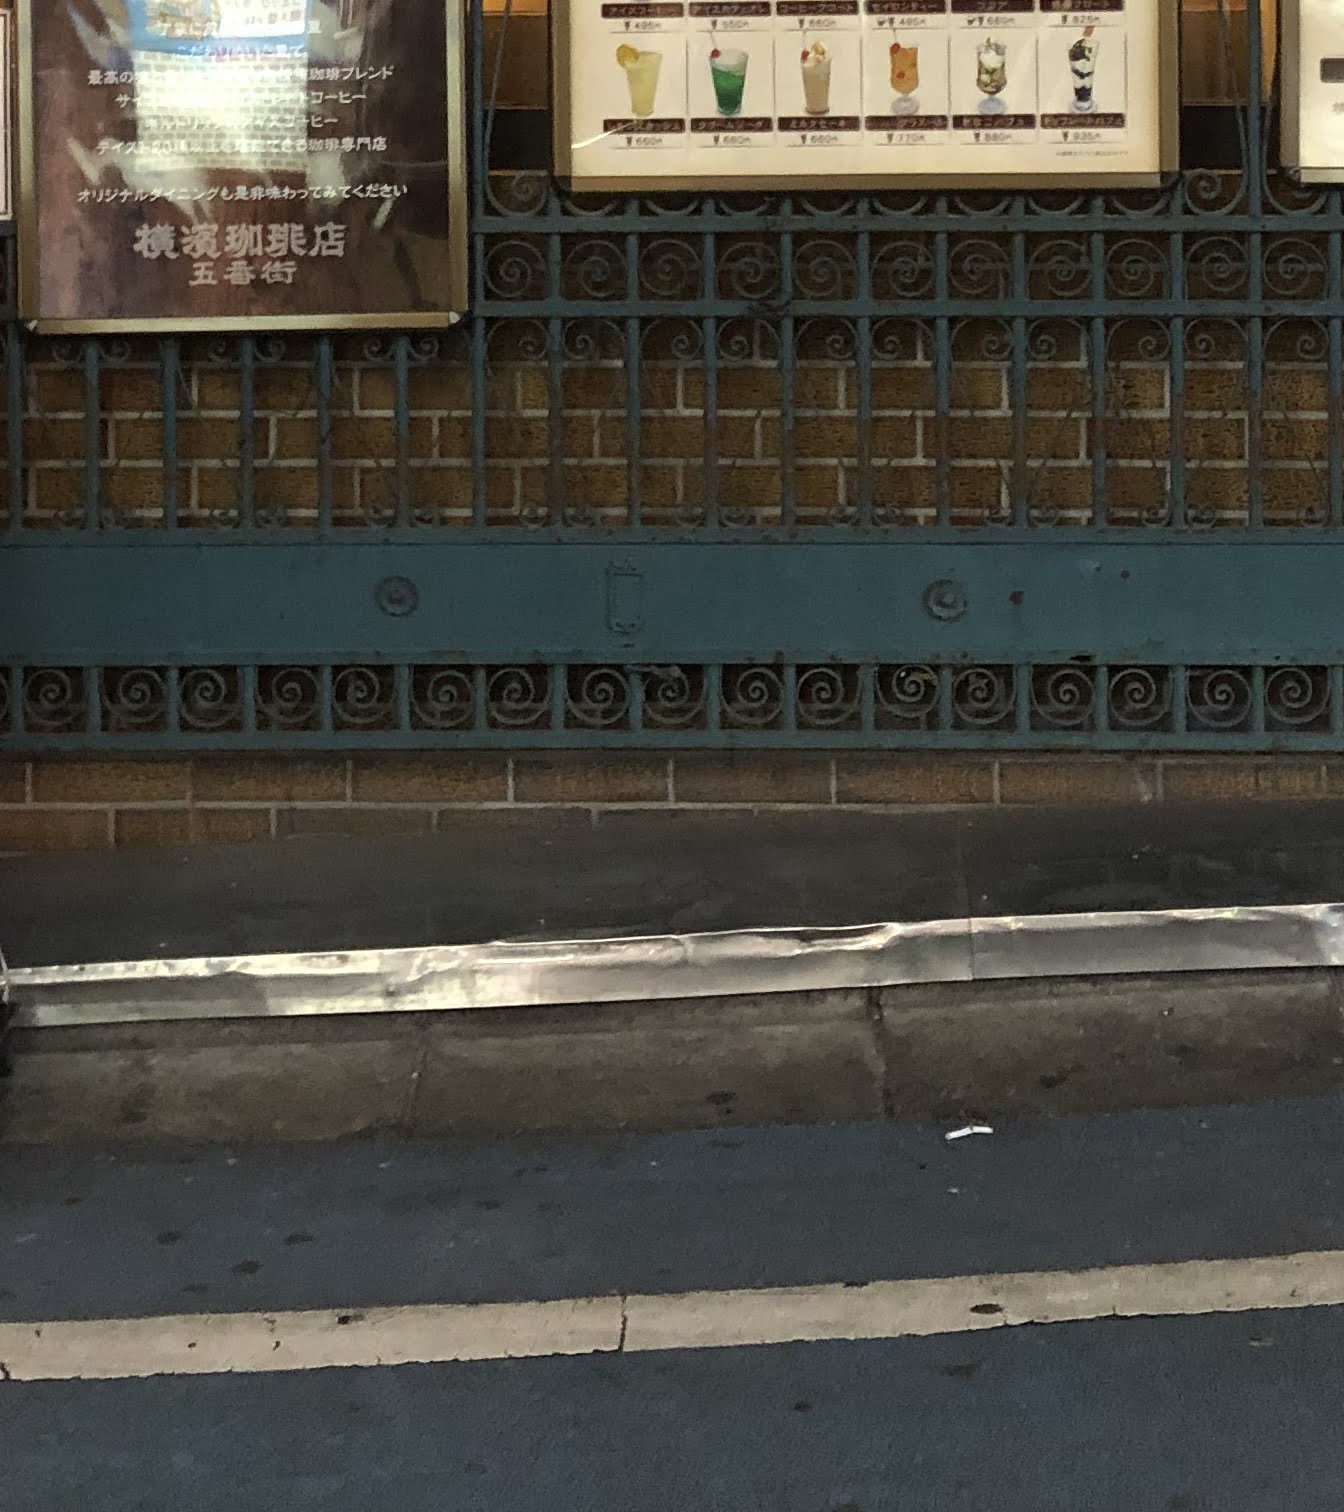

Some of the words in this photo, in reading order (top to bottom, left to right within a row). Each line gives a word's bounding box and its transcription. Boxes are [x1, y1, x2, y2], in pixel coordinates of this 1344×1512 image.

[133, 221, 347, 259] 横濱珈琲店
[188, 262, 298, 287] 五番街
